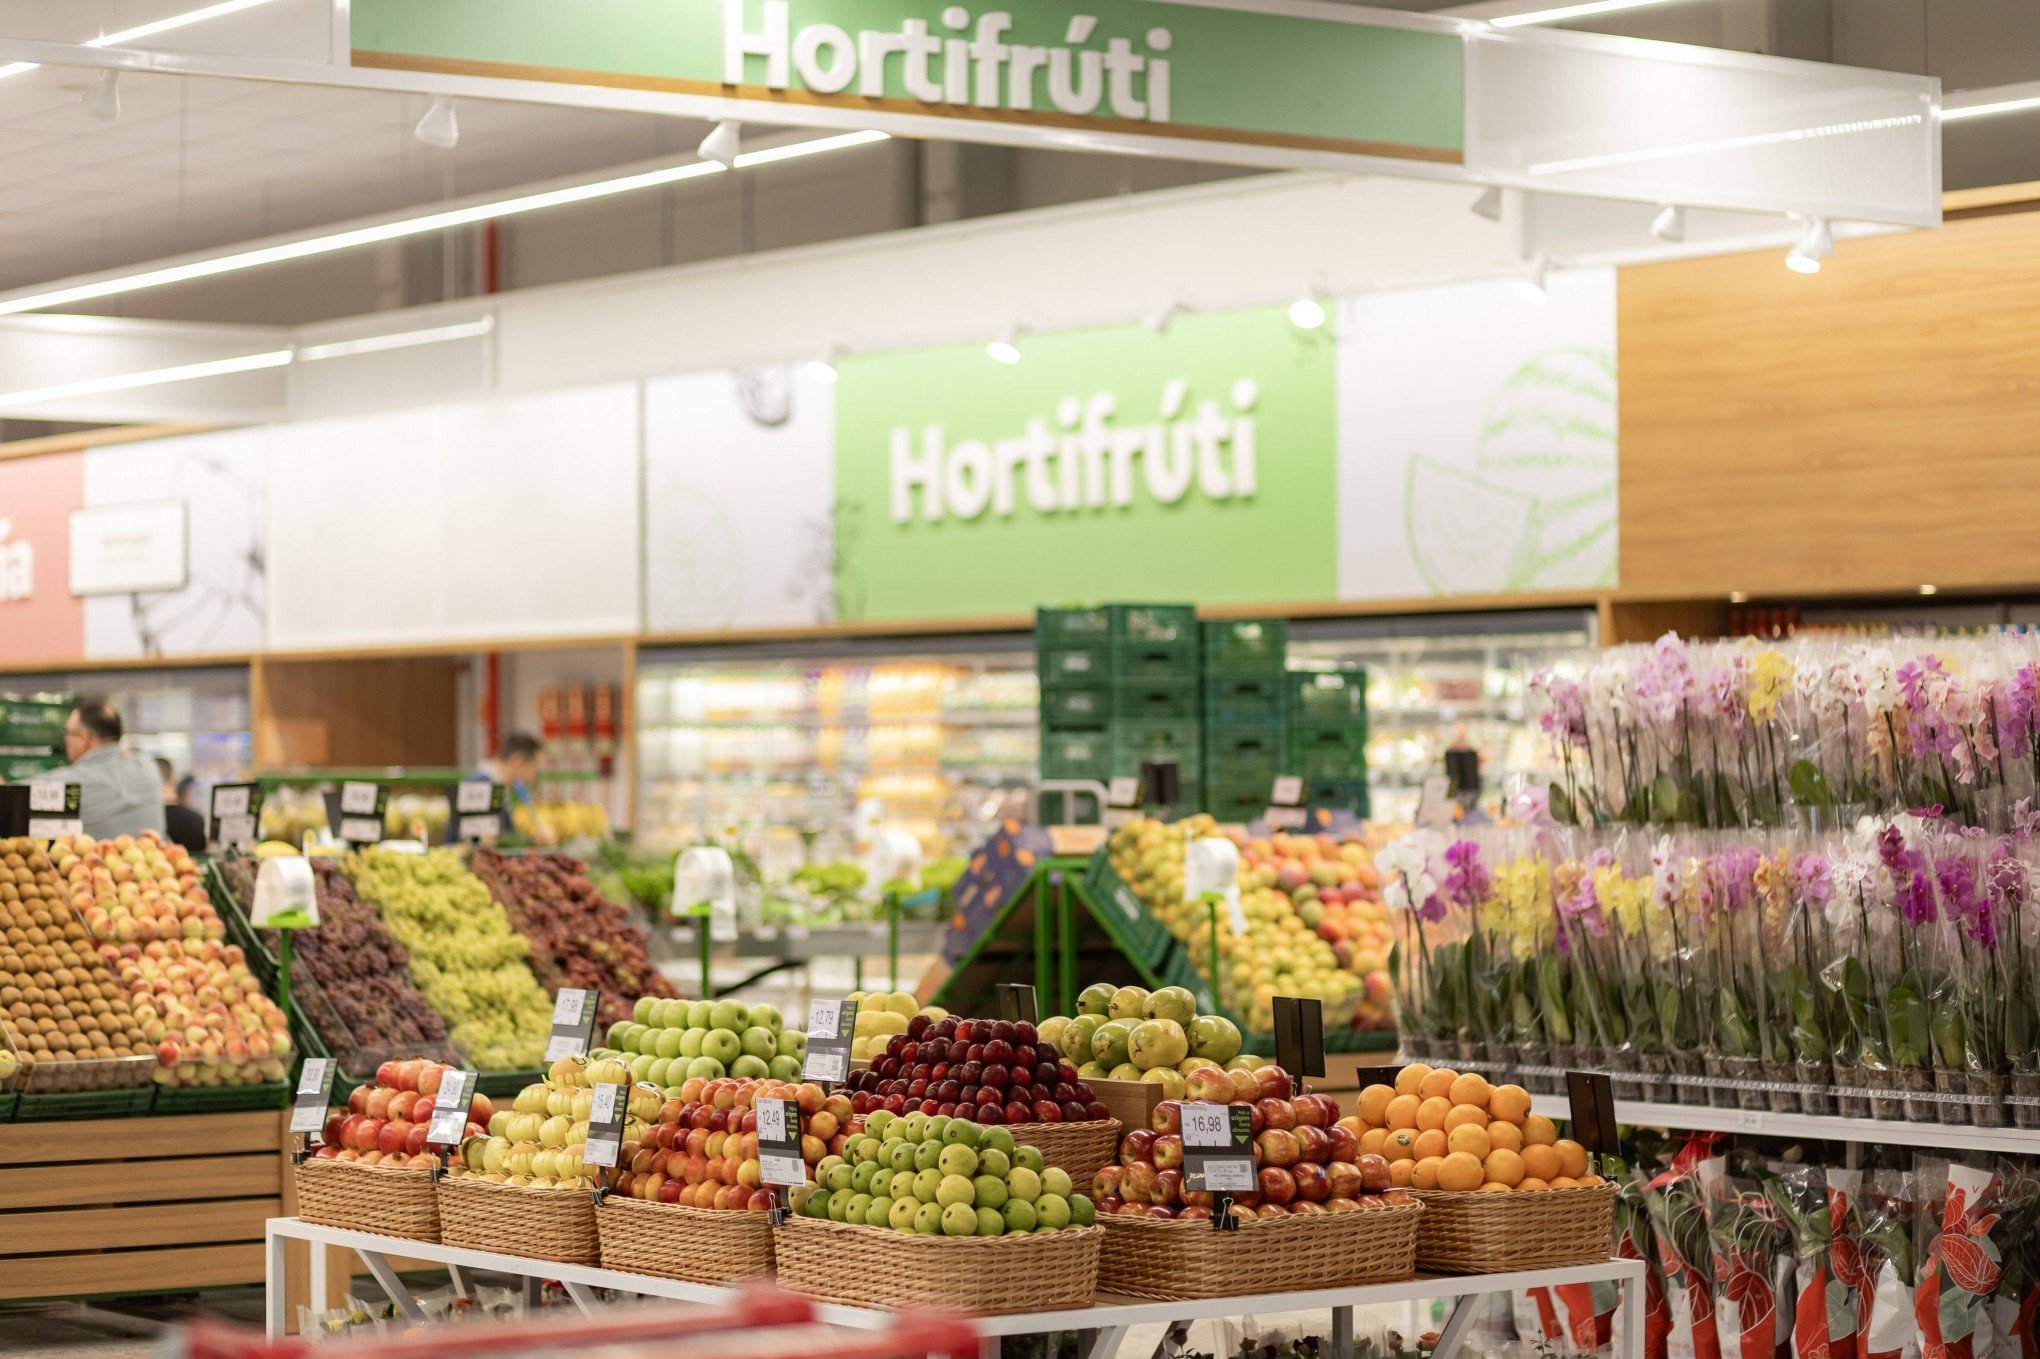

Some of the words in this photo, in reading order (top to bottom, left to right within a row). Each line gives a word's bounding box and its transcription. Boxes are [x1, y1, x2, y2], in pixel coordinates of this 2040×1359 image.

[722, 0, 1173, 122] Hortifrúti
[889, 379, 1259, 523] Hortifrúti
[815, 1010, 835, 1026] 12,79
[762, 1109, 780, 1128] 12,49
[1192, 1116, 1222, 1134] 16,98
